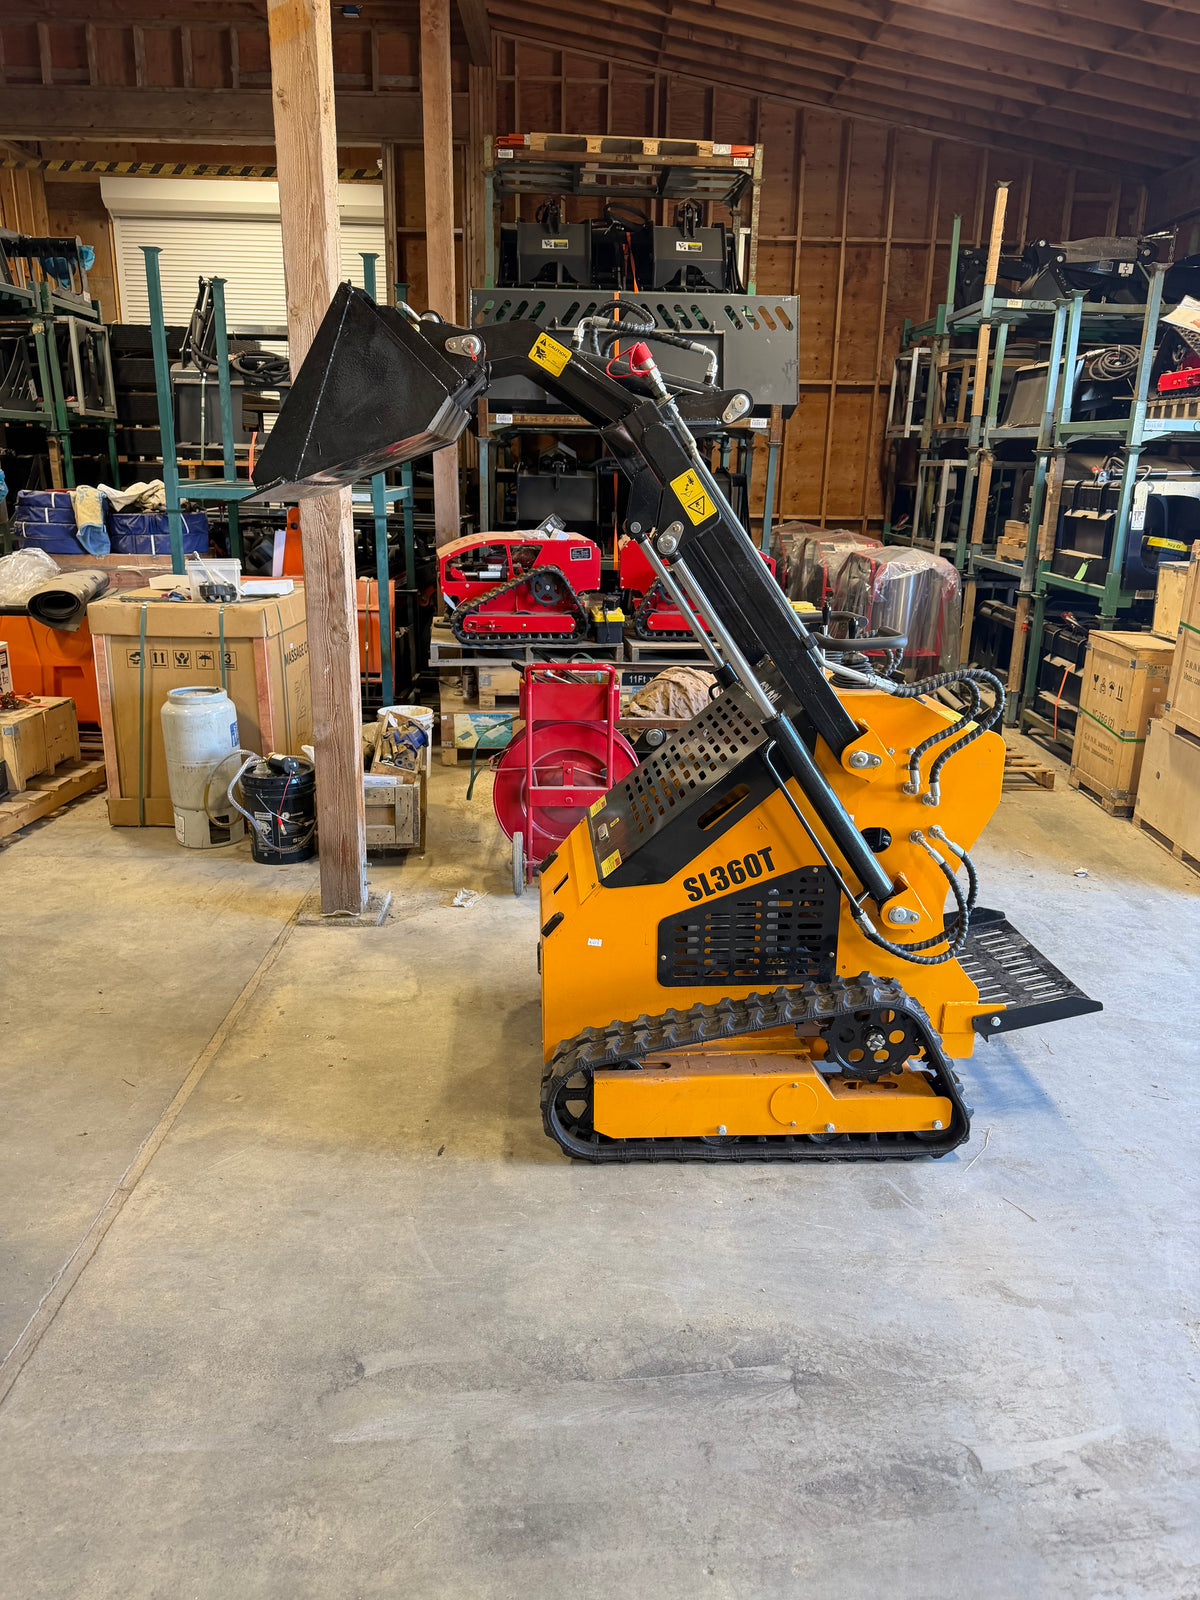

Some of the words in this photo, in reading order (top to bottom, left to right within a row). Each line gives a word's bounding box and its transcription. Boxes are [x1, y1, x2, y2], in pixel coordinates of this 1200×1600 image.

[548, 343, 568, 359] CAUTION
[284, 643, 304, 666] MASSAGE
[682, 845, 776, 902] SL360T
